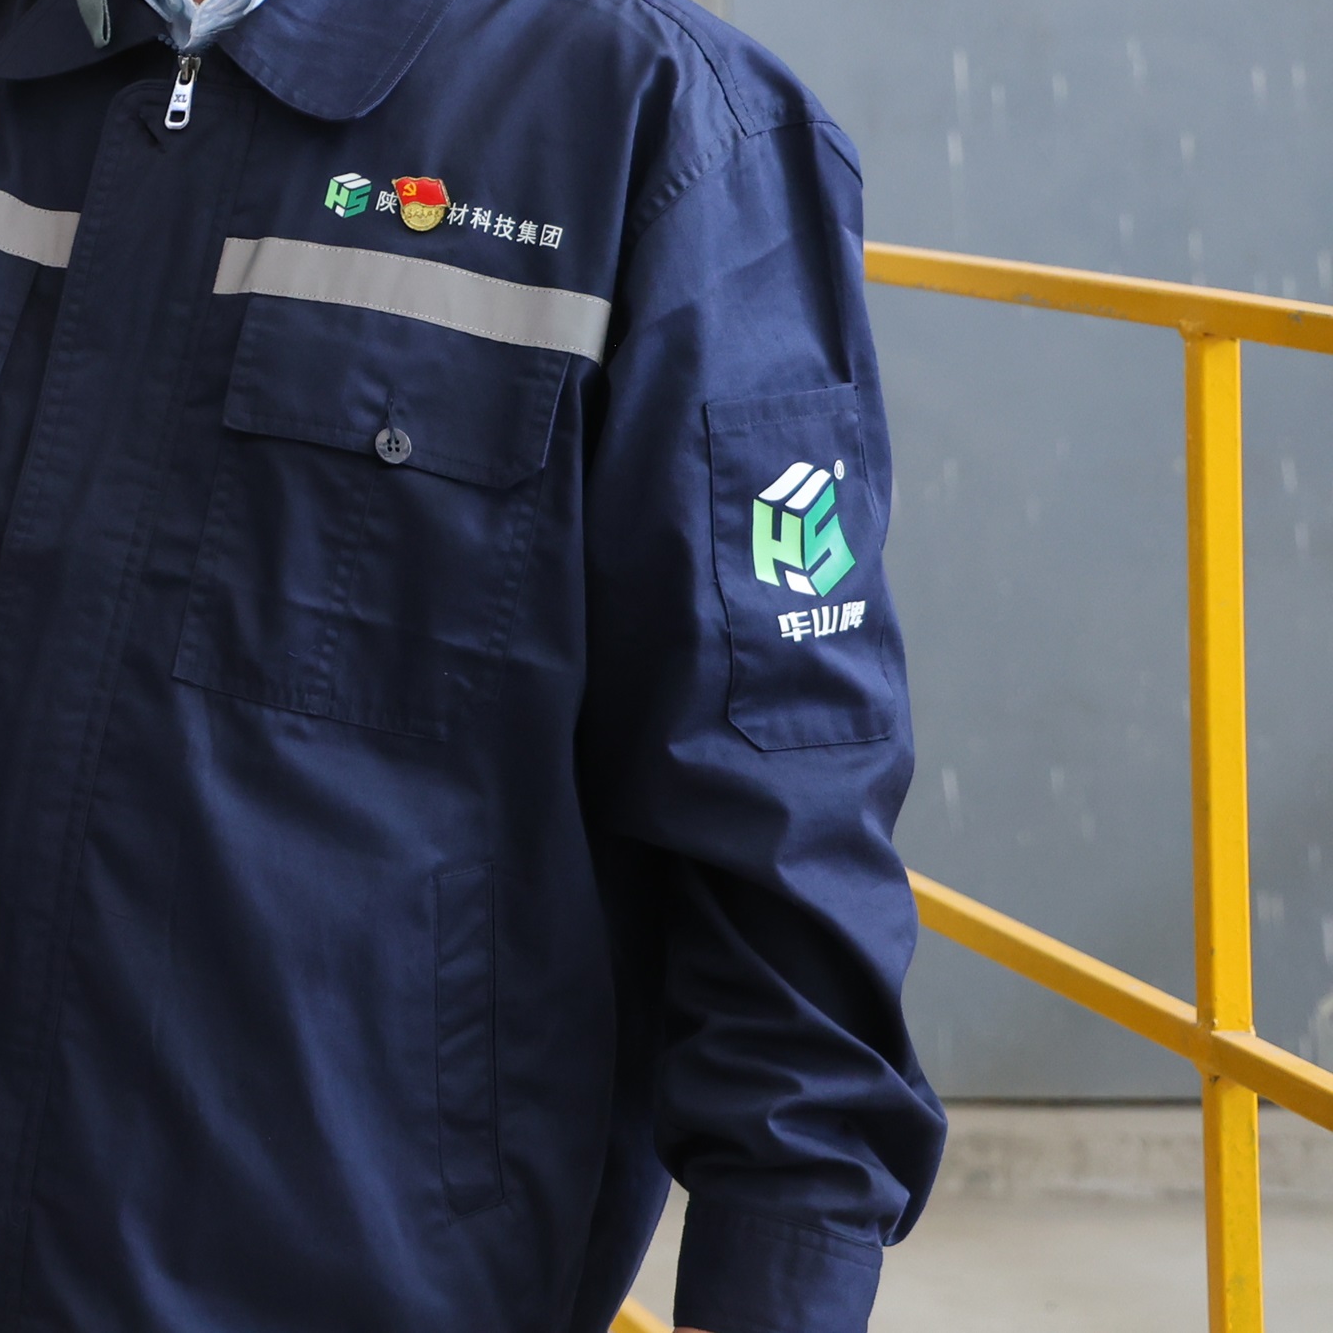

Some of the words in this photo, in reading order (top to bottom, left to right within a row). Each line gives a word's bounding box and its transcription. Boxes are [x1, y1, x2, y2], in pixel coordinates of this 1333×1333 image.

[173, 93, 188, 104] XL
[374, 190, 564, 250] 陕材科技集团
[776, 599, 867, 643] 华山牌
